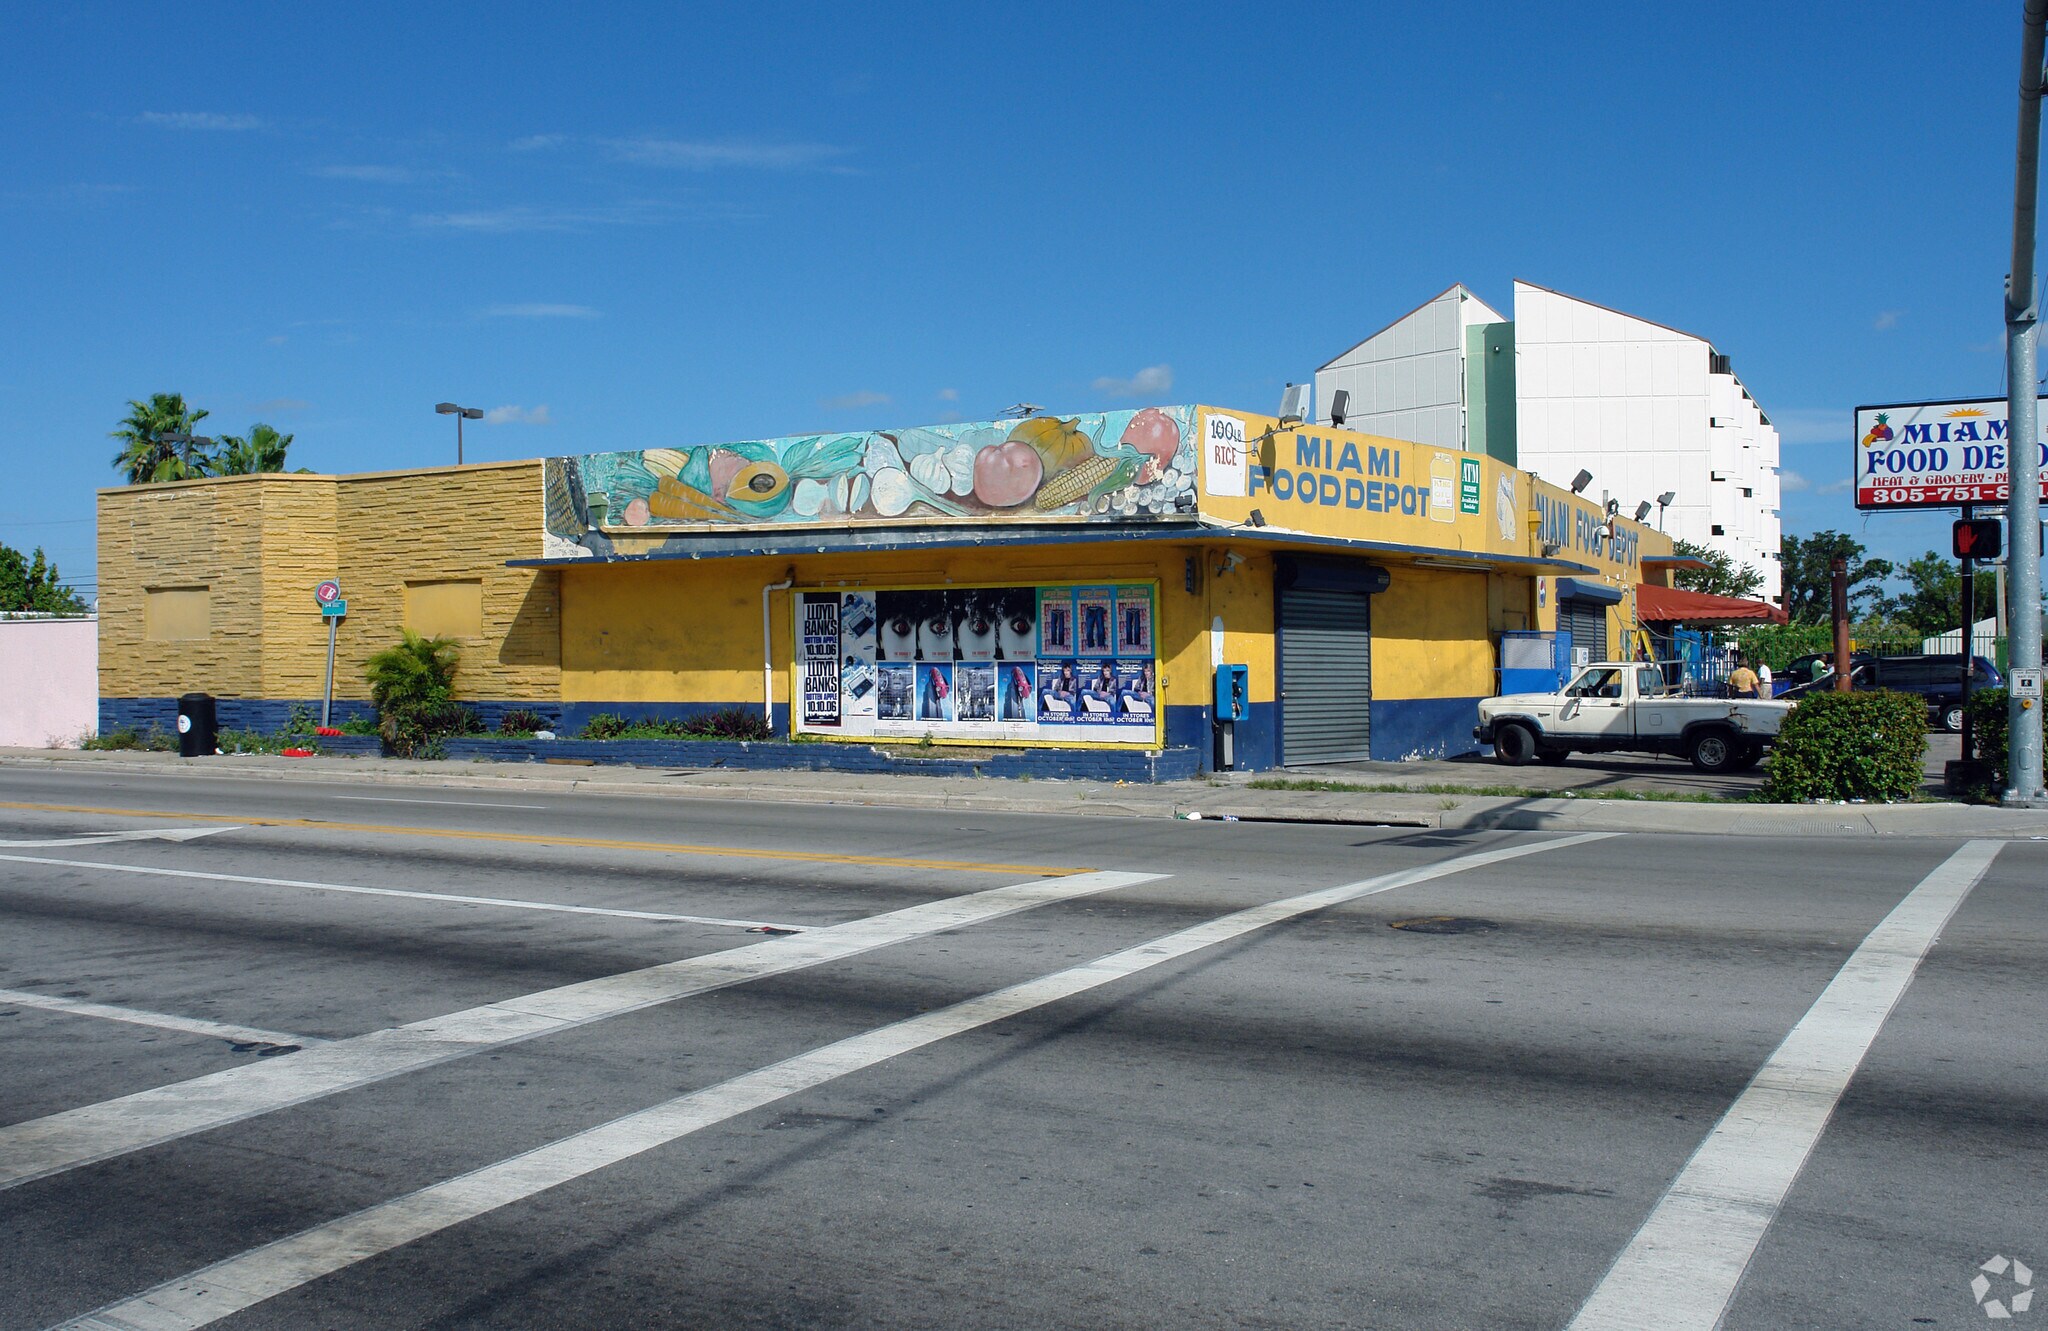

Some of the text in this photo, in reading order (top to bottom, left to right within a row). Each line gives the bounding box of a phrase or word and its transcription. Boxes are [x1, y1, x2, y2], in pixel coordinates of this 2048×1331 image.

[1901, 419, 2009, 445] MIAM
[1214, 445, 1237, 466] RICE
[1296, 434, 1400, 478] MIAMI
[1867, 447, 1949, 475] FOOD
[1461, 463, 1479, 483] ATM
[1872, 475, 1904, 487] MEAT
[1909, 475, 1920, 486] &
[1925, 472, 1985, 486] GROCERY
[1249, 465, 1430, 517] FOOD DEPOT
[1536, 493, 1569, 548] MIAMI
[807, 604, 834, 620] LLOYD
[805, 620, 837, 636] BANKS
[806, 644, 836, 655] 10.10.06
[808, 661, 835, 676] LLOYD
[806, 677, 837, 692] BANKS
[807, 701, 837, 712] 10.10.06
